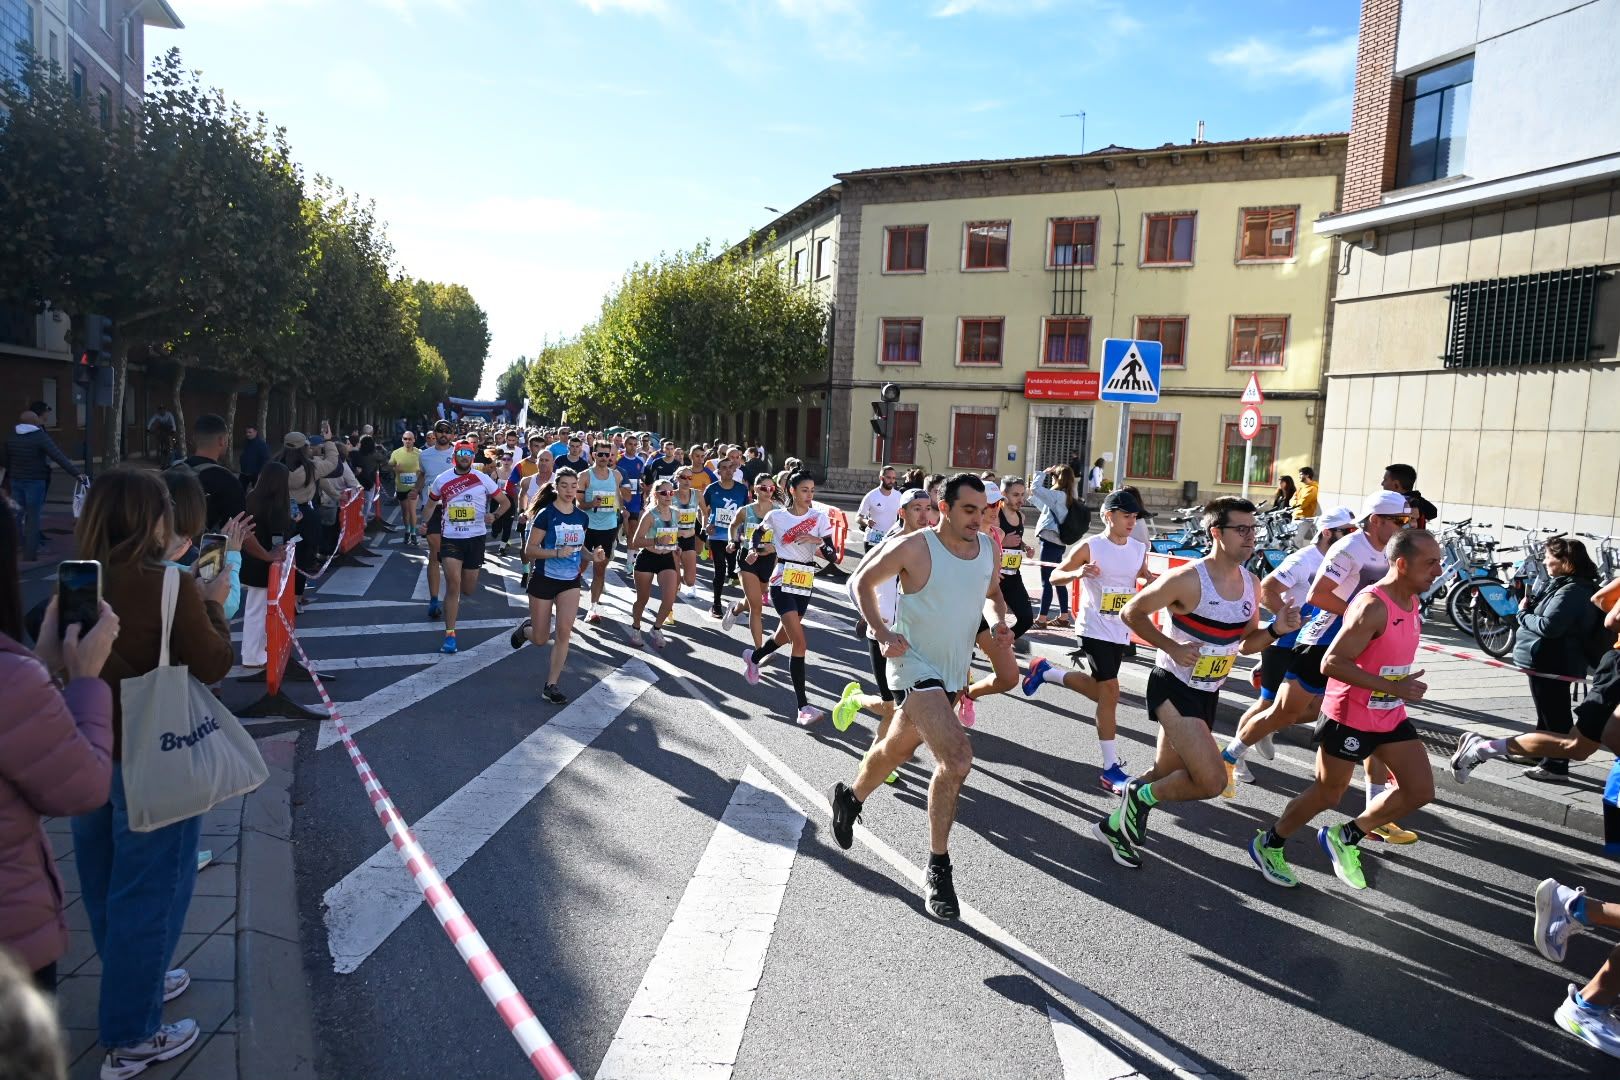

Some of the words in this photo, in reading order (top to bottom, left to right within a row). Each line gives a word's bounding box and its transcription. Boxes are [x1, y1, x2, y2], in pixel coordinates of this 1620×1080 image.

[1243, 417, 1255, 428] 30
[455, 509, 467, 518] 109
[564, 533, 579, 543] 846
[791, 572, 806, 584] 200
[1112, 596, 1127, 609] 165
[1210, 659, 1228, 675] 147
